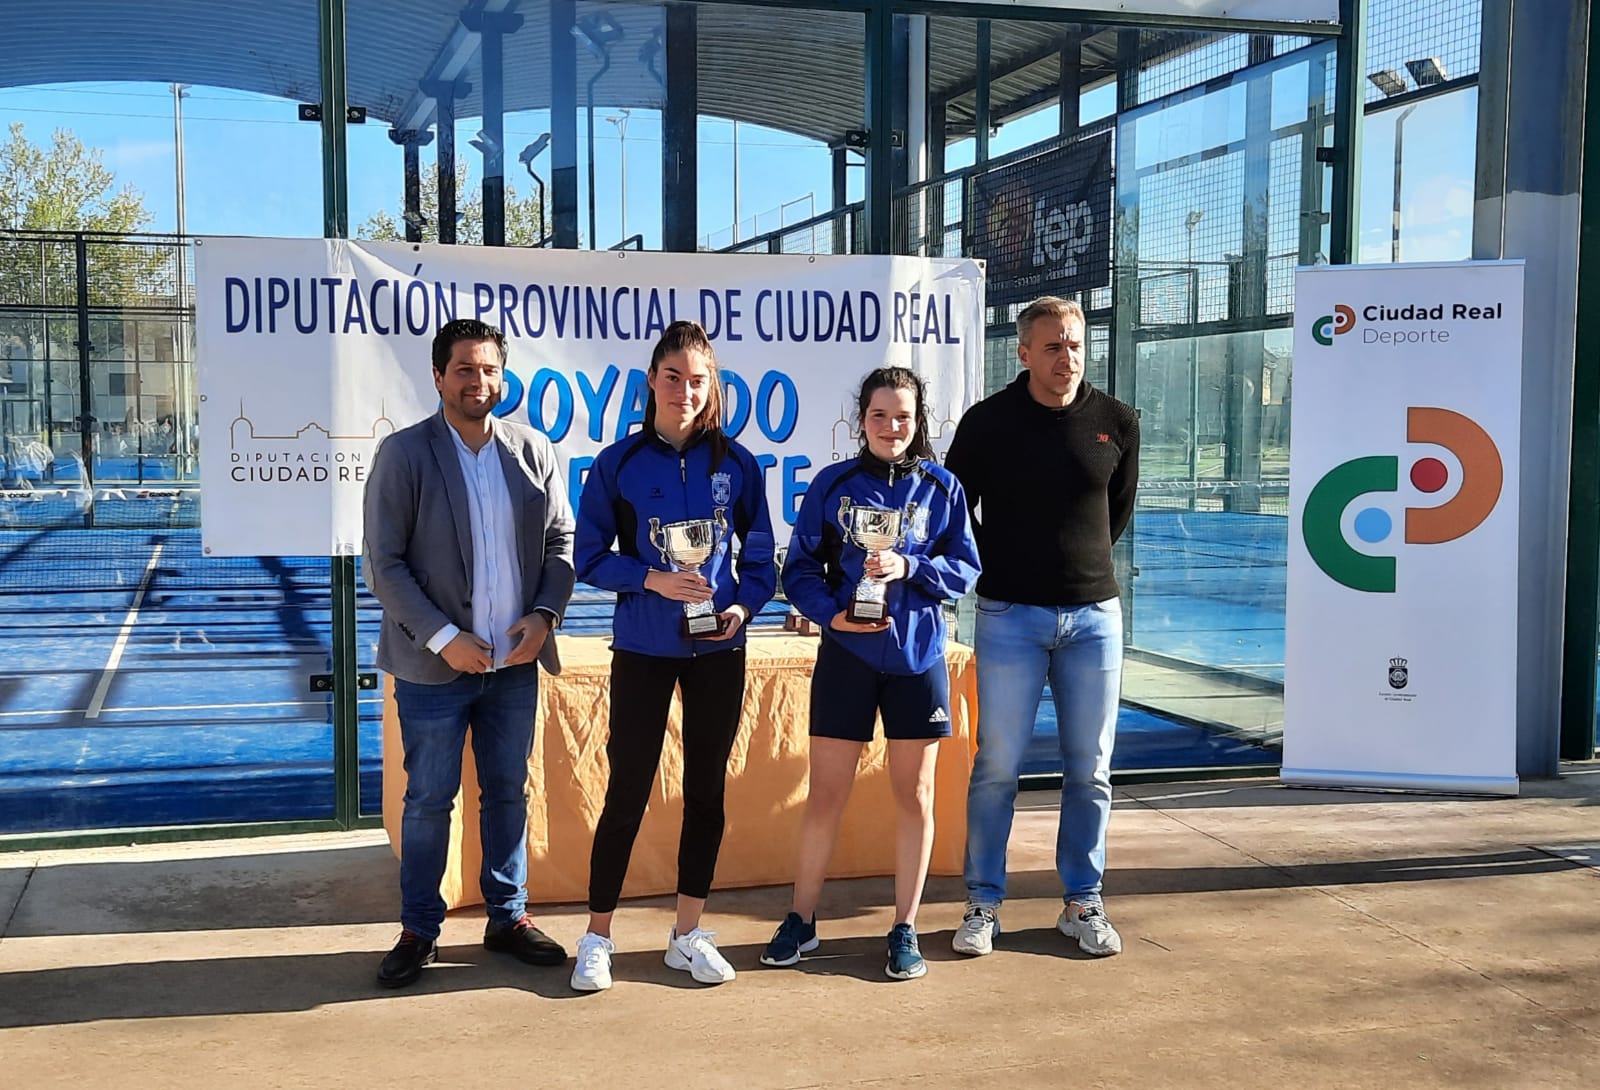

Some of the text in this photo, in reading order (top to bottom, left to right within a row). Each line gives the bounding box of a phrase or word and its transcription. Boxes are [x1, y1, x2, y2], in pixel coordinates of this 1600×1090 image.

[225, 264, 457, 335] DIPUTACIÓN
[700, 288, 743, 341] DE
[755, 289, 881, 343] CIUDAD
[894, 291, 961, 345] REAL
[1362, 302, 1502, 321] Ciudad Real
[1362, 328, 1450, 346] Deporte
[231, 466, 365, 482] CIUDAD RE
